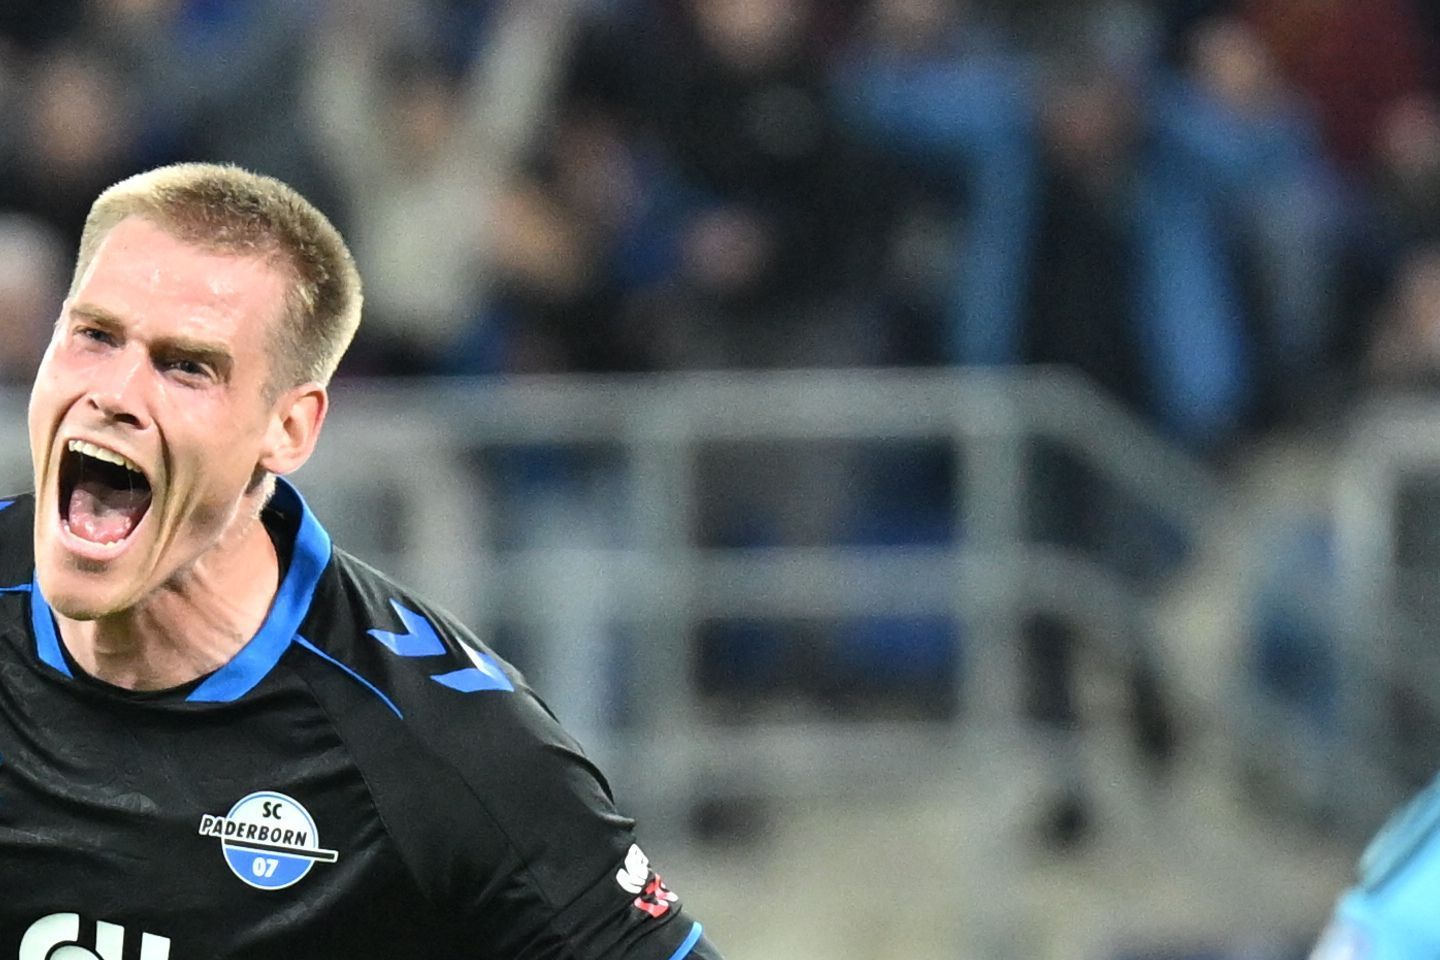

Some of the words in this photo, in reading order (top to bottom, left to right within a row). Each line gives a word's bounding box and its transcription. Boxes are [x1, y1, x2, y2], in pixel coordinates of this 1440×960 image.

[262, 801, 282, 820] SC
[202, 817, 308, 847] PADERBORN
[252, 856, 279, 878] 07
